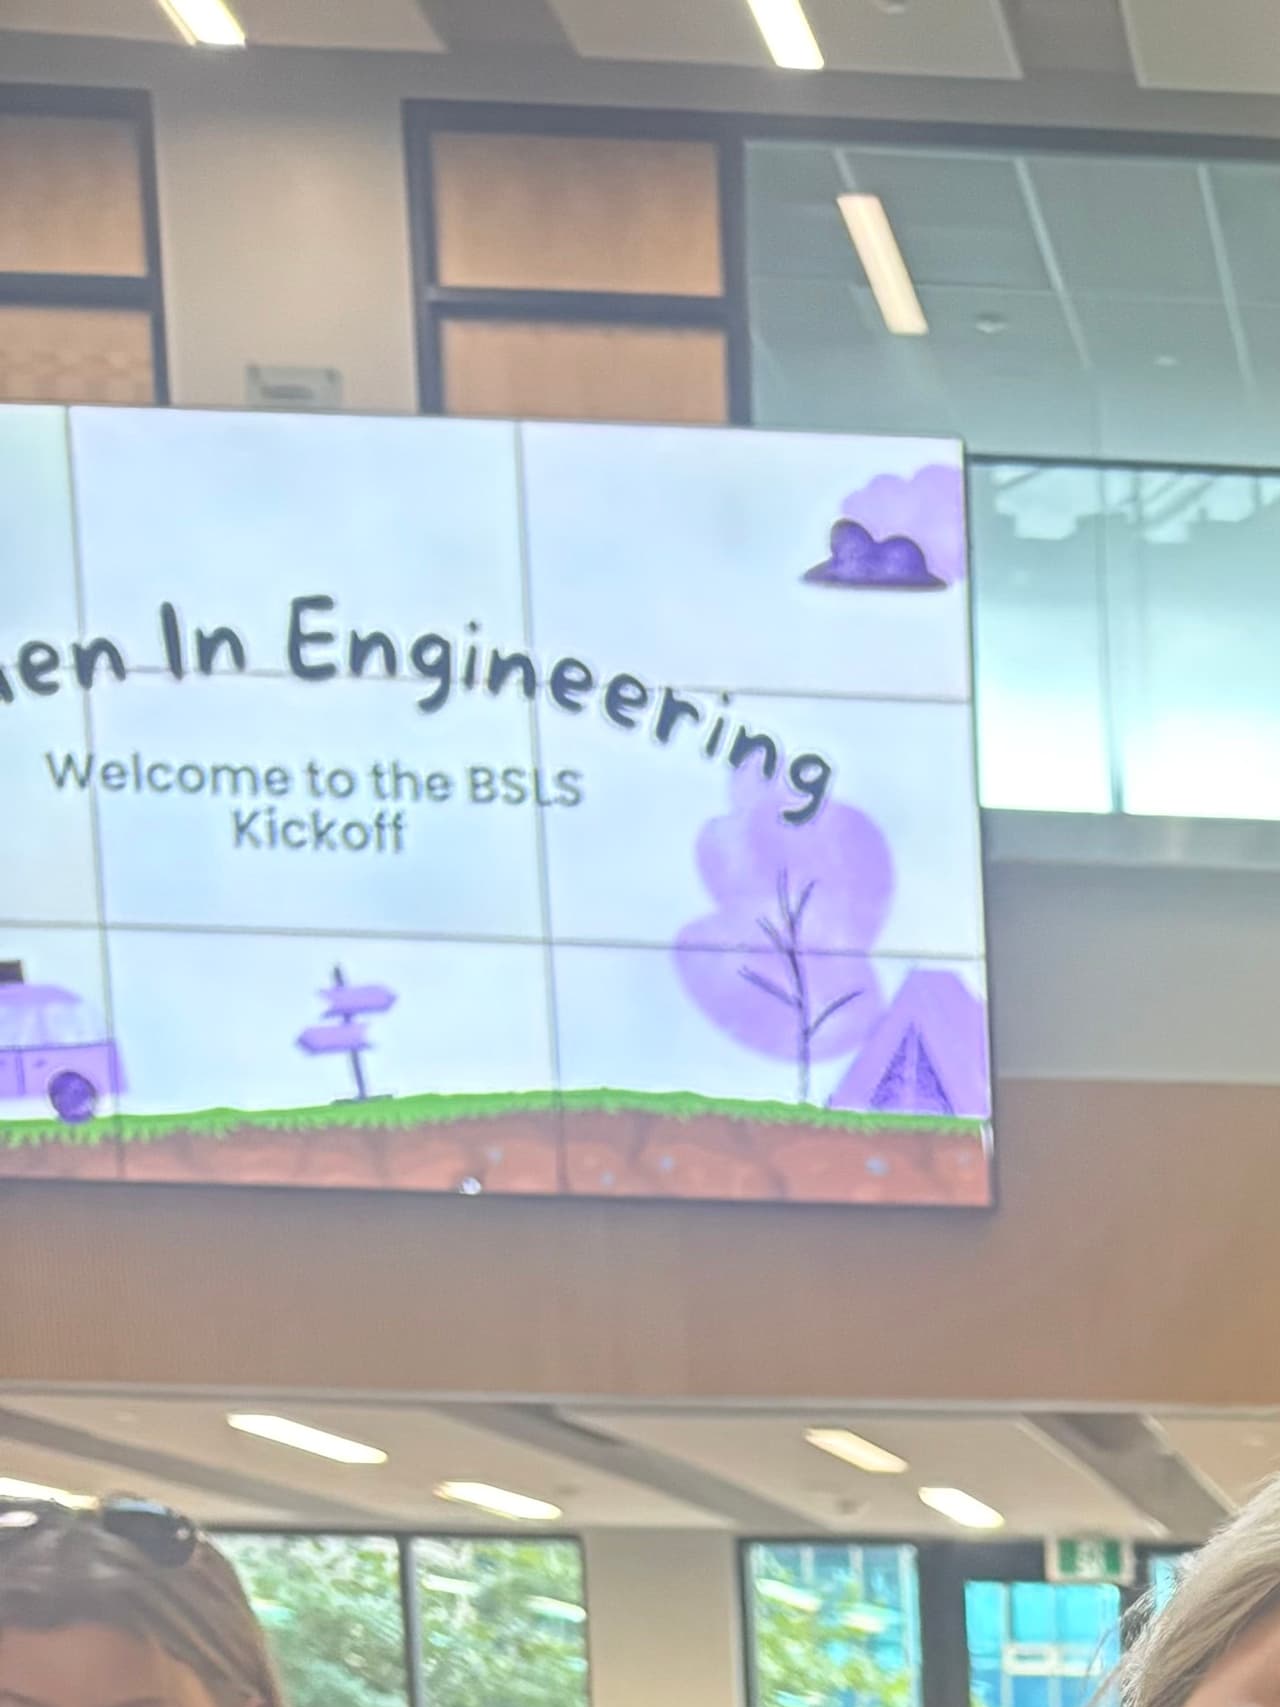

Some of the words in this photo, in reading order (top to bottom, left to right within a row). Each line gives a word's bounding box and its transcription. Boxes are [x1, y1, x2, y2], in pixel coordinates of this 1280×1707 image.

[160, 600, 247, 680] In
[287, 594, 833, 824] Engineering
[46, 752, 290, 796] Welcome
[306, 762, 354, 797] to
[371, 764, 453, 802] the
[469, 767, 584, 807] BSLS
[233, 811, 406, 852] Kickoff
